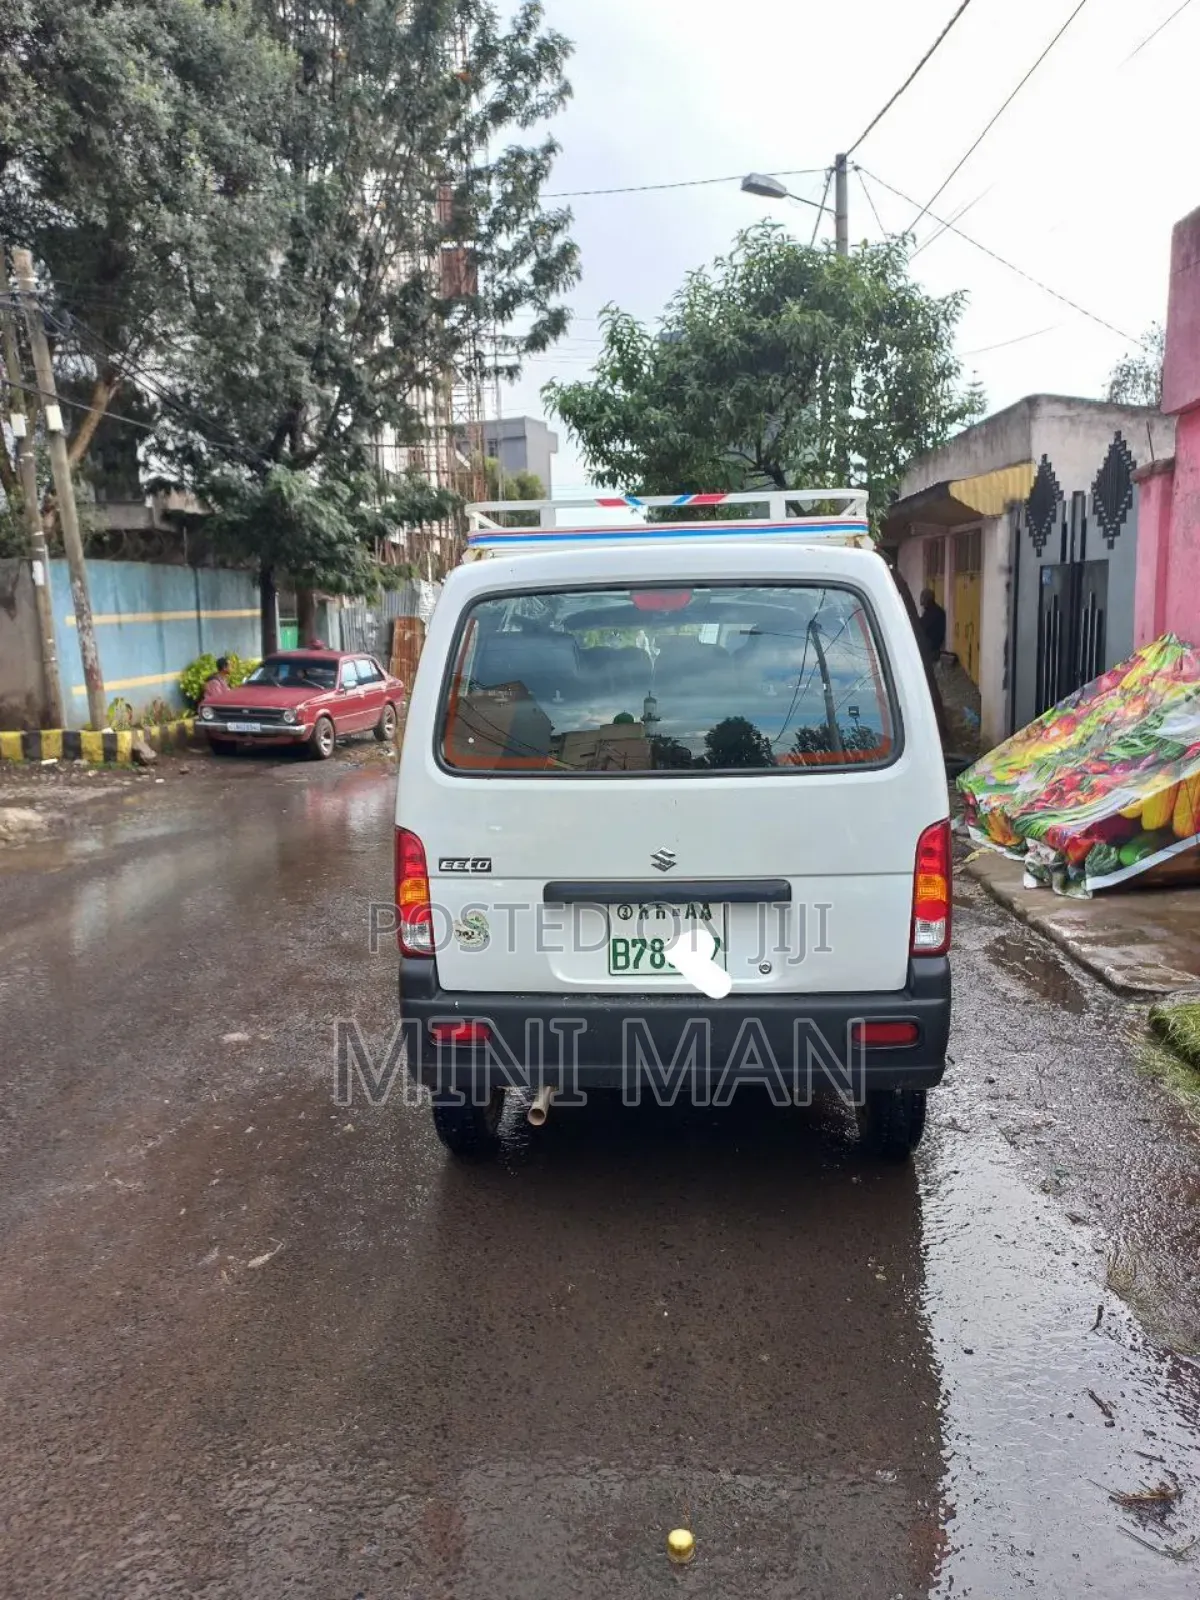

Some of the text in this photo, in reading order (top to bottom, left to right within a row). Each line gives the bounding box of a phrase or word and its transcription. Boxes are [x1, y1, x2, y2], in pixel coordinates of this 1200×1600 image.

[439, 859, 491, 871] EECO
[685, 903, 712, 921] AA
[611, 937, 721, 970] B78
